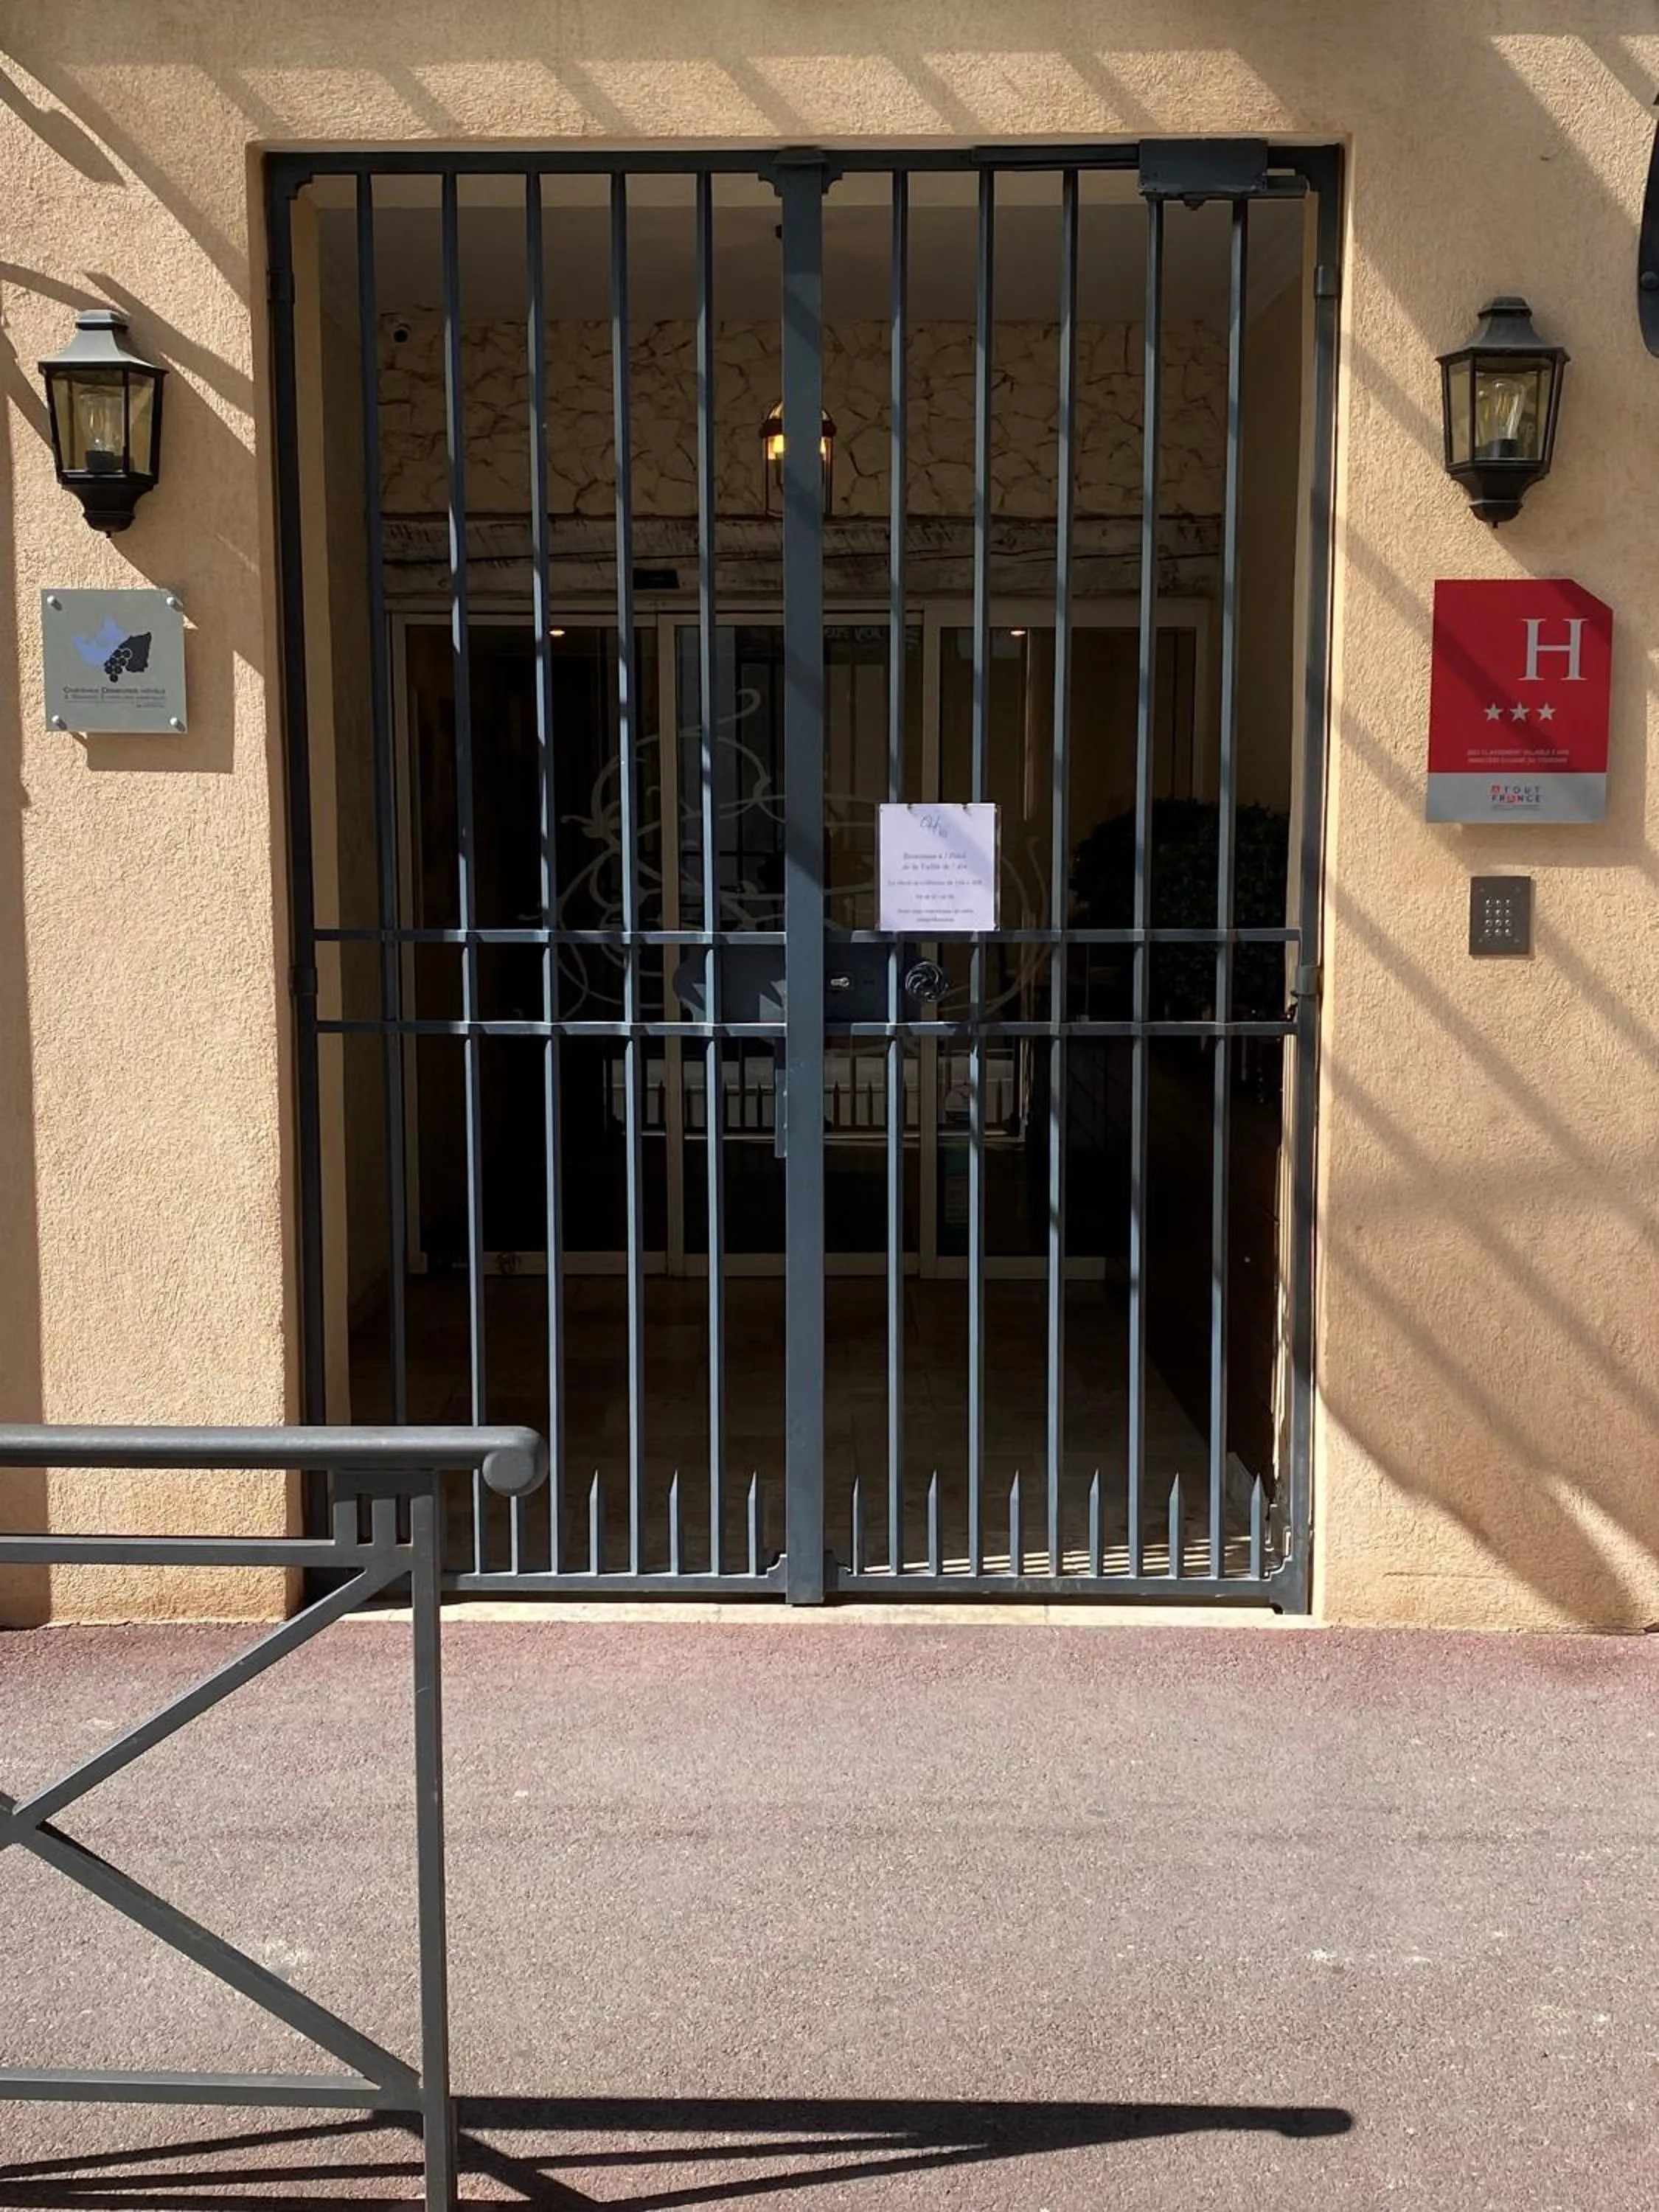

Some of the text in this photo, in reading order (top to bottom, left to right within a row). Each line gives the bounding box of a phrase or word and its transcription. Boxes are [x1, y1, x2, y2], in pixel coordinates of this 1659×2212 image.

[1517, 618, 1589, 681] H
[1491, 785, 1542, 794] ATOUT
[1491, 794, 1543, 803] FRANCE
